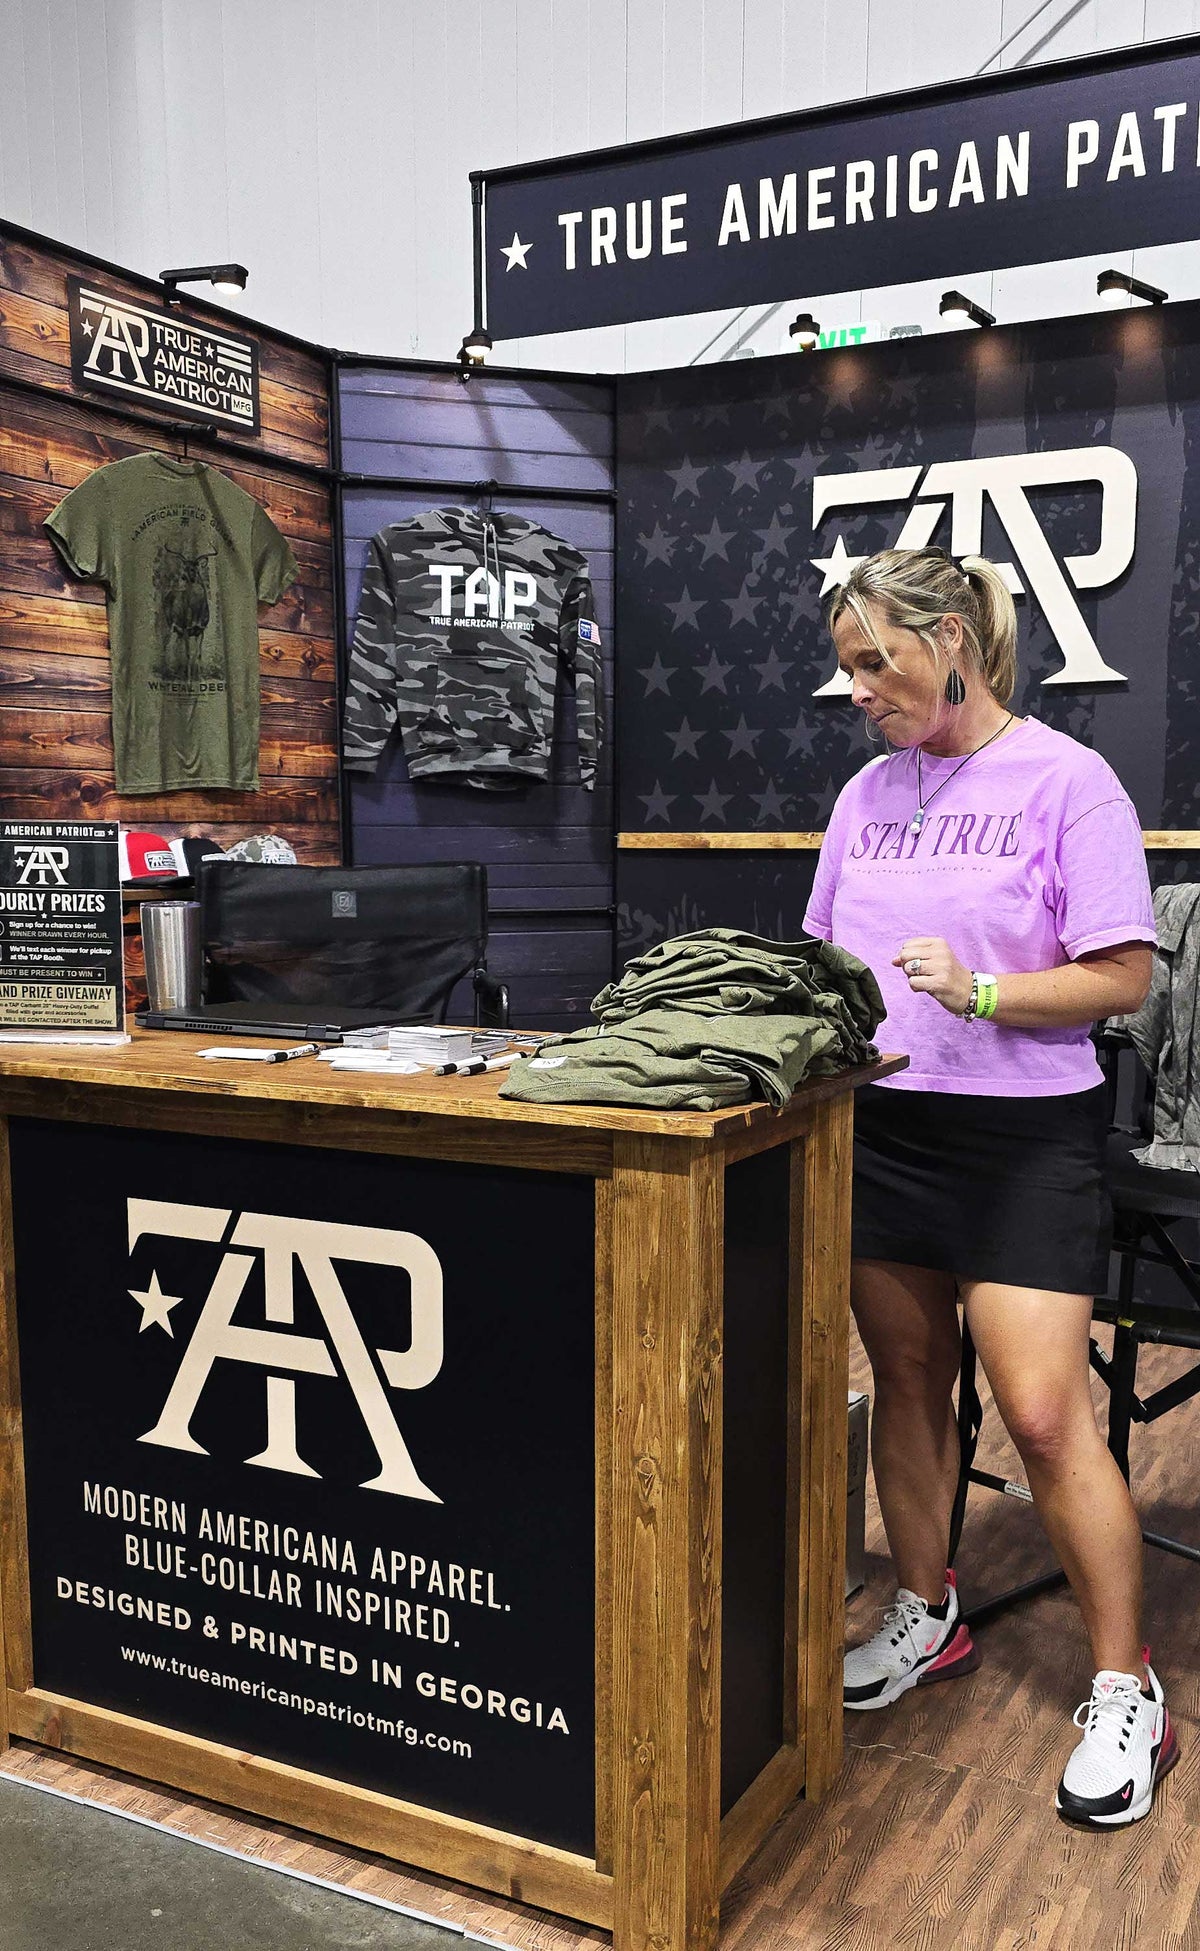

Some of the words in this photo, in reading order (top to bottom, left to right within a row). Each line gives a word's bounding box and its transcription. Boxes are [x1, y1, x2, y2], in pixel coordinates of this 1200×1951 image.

[557, 194, 687, 270] TRUE
[718, 131, 1029, 246] AMERICAN
[1067, 102, 1200, 188] PAT
[152, 323, 201, 356] TRUE
[153, 349, 252, 395] AMERICAN
[154, 370, 230, 409] PATRIOT
[233, 396, 251, 412] MFG
[429, 565, 537, 620] TAP
[429, 616, 452, 626] TRUE
[454, 619, 498, 629] AMERICAN
[500, 621, 535, 631] PATRIOT
[5, 825, 52, 836] AMERICAN
[56, 826, 94, 837] PATRIOT
[849, 817, 932, 860] STAY
[931, 811, 1022, 858] TRUE
[51, 894, 105, 912] PRIZES
[9, 921, 24, 929] Sign
[90, 947, 112, 955] pickup
[19, 968, 29, 976] BE
[31, 969, 65, 977] PRESENT
[79, 970, 93, 978] WIN
[22, 985, 53, 998] PRIZE
[56, 986, 112, 1000] GIVEAWAY
[83, 1481, 185, 1534] MODERN
[199, 1509, 357, 1576] AMERICANA
[371, 1548, 511, 1612] APPAREL.
[126, 1534, 301, 1607] BLUE-COLLAR
[316, 1580, 460, 1648] INSPIRED.
[57, 1576, 191, 1631] DESIGNED
[203, 1615, 220, 1640] &
[231, 1621, 358, 1676] PRINTED
[372, 1658, 402, 1688] IN
[416, 1672, 570, 1734] GEORGIA
[121, 1647, 472, 1758] www.trueamericanpatriotmfg.com
